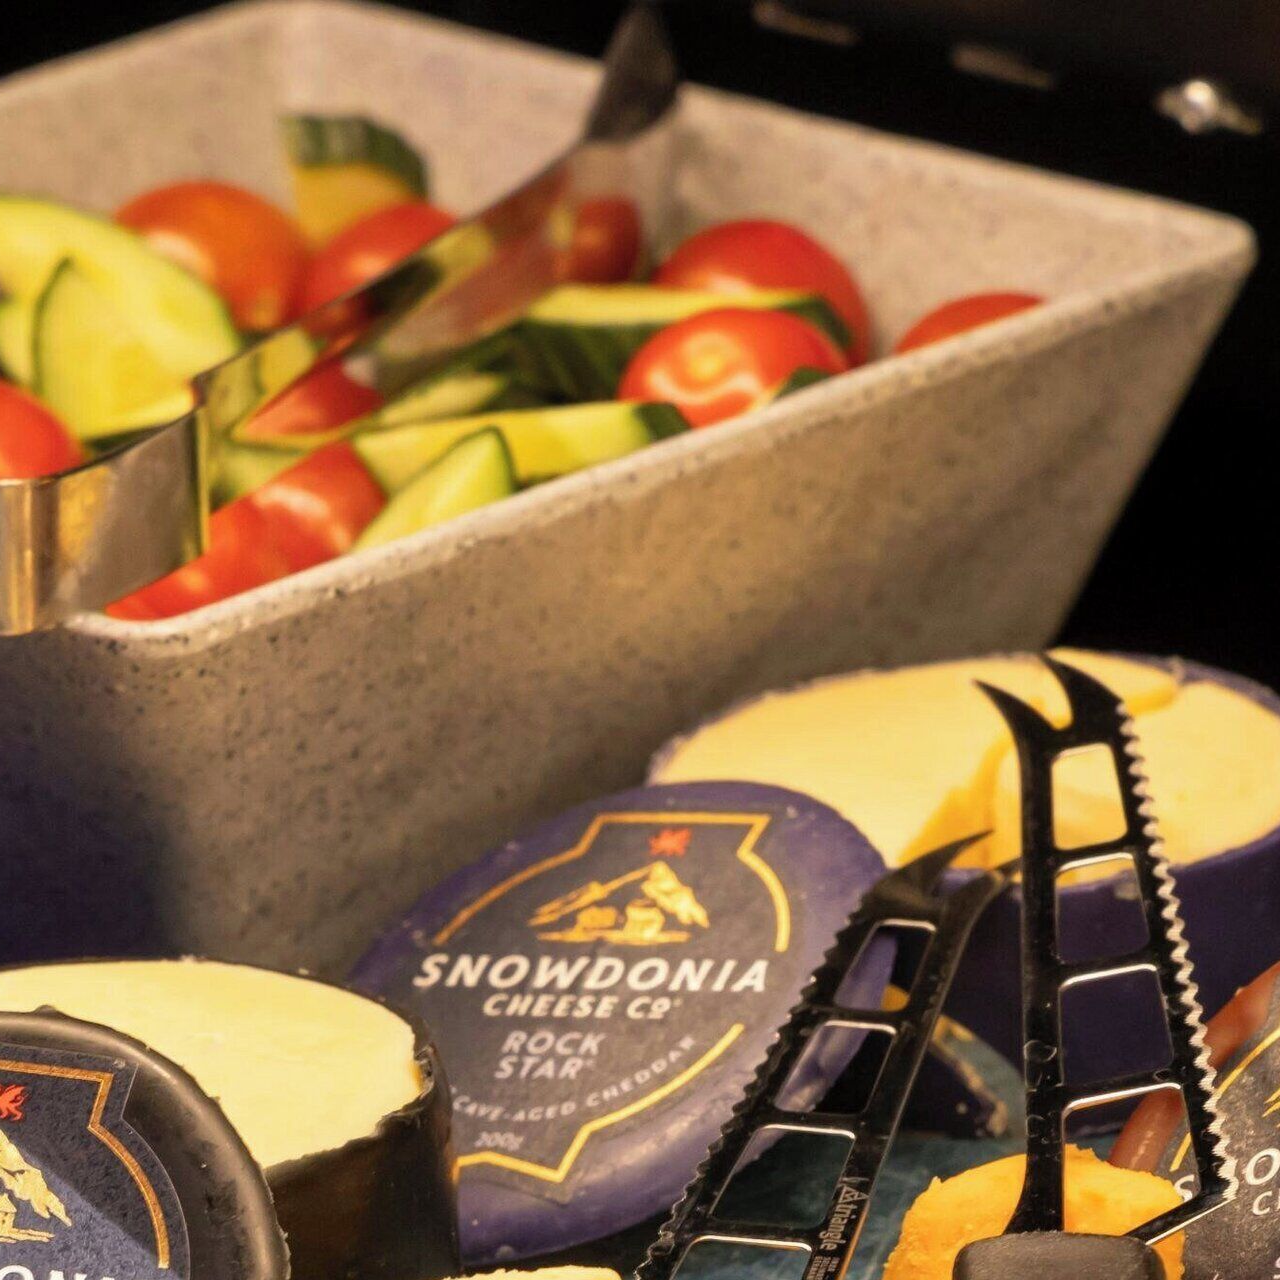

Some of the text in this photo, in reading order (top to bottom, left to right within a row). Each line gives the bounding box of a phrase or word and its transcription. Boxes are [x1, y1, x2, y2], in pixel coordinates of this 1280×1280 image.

[413, 952, 769, 993] SNOWDONIA
[483, 993, 620, 1020] CHEESE
[501, 1029, 608, 1056] ROCK
[585, 1034, 696, 1108] CHEDDAR
